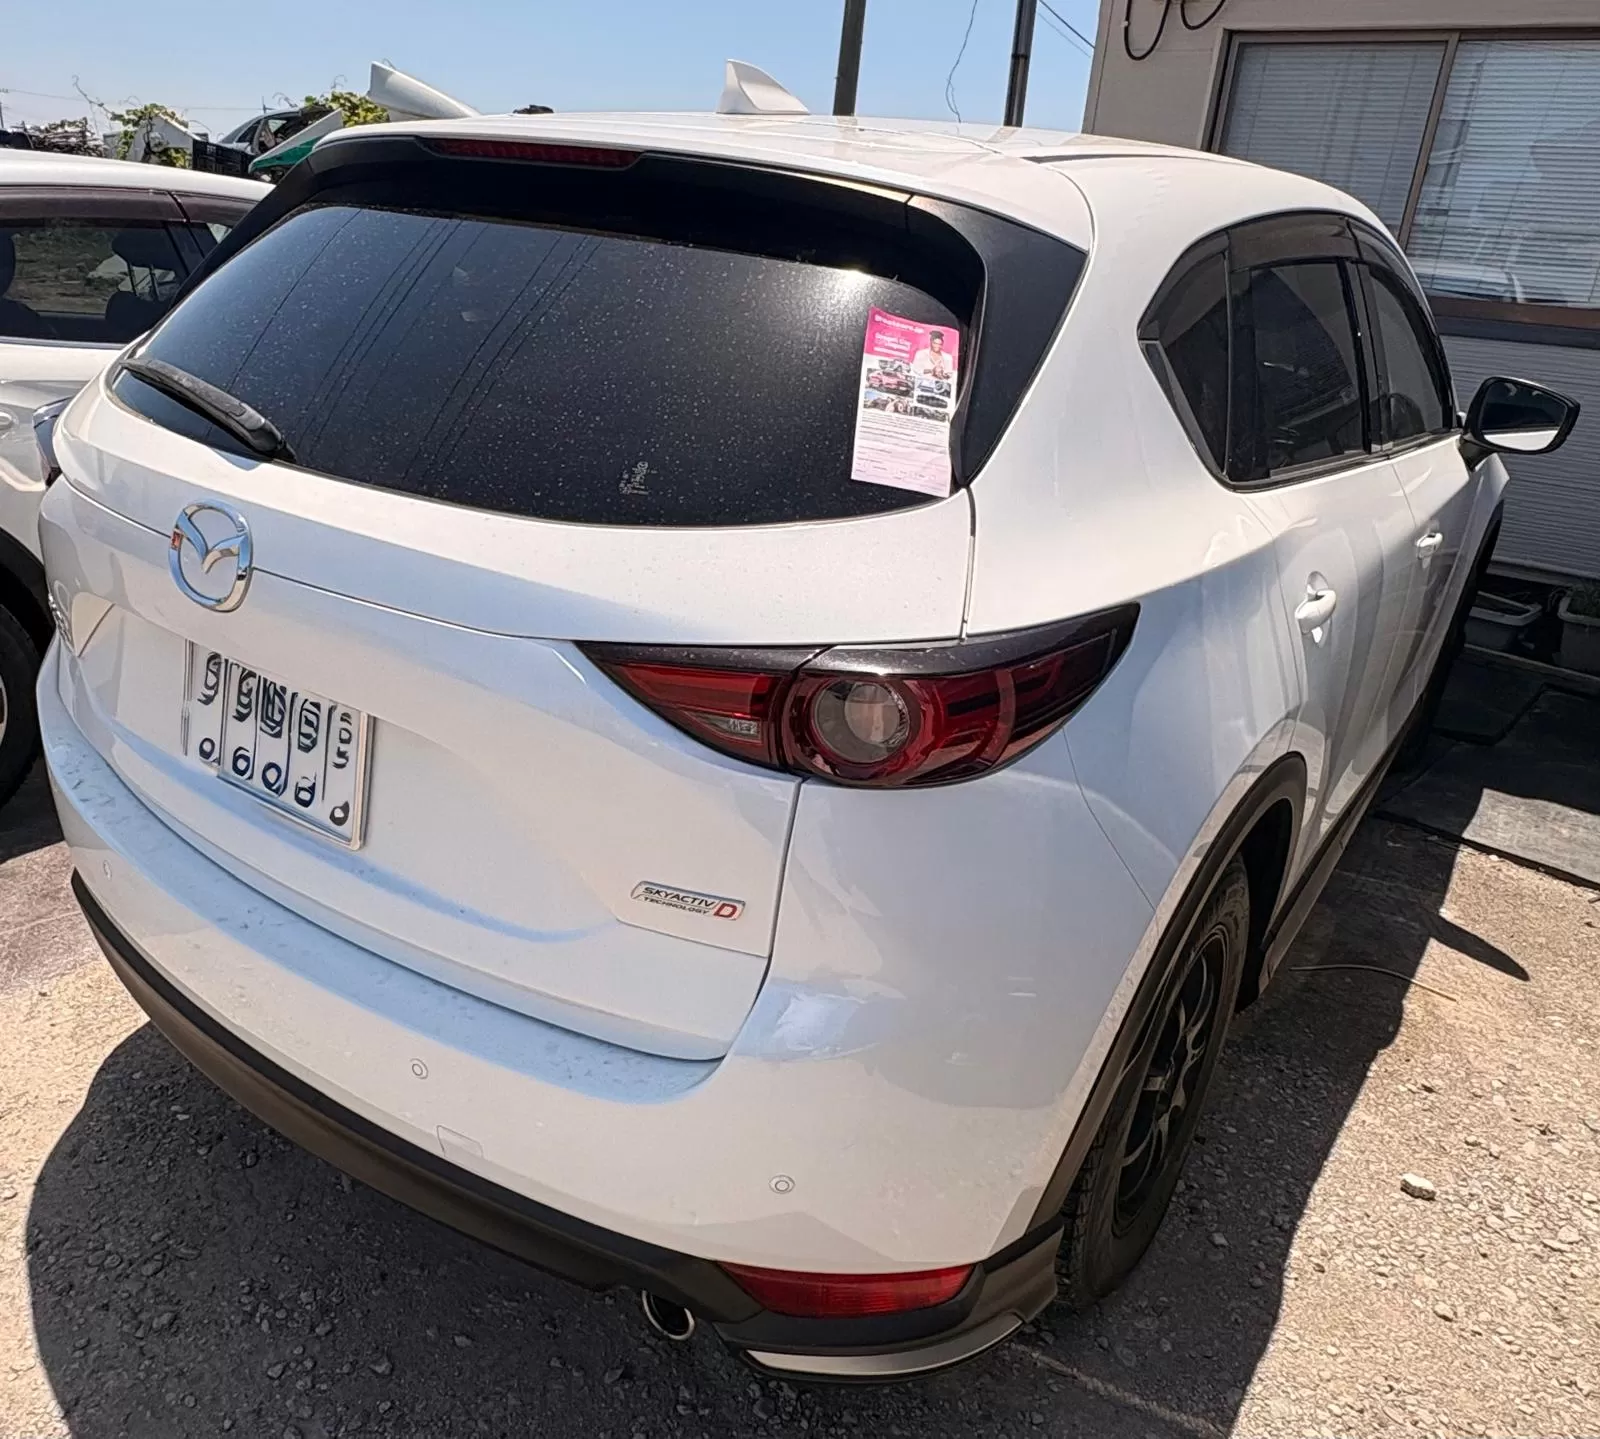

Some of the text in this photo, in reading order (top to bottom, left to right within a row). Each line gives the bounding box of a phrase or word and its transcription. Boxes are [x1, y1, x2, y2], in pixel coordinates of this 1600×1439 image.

[642, 886, 738, 918] SKYACTIV D
[643, 896, 711, 915] TECHNOLOGY
